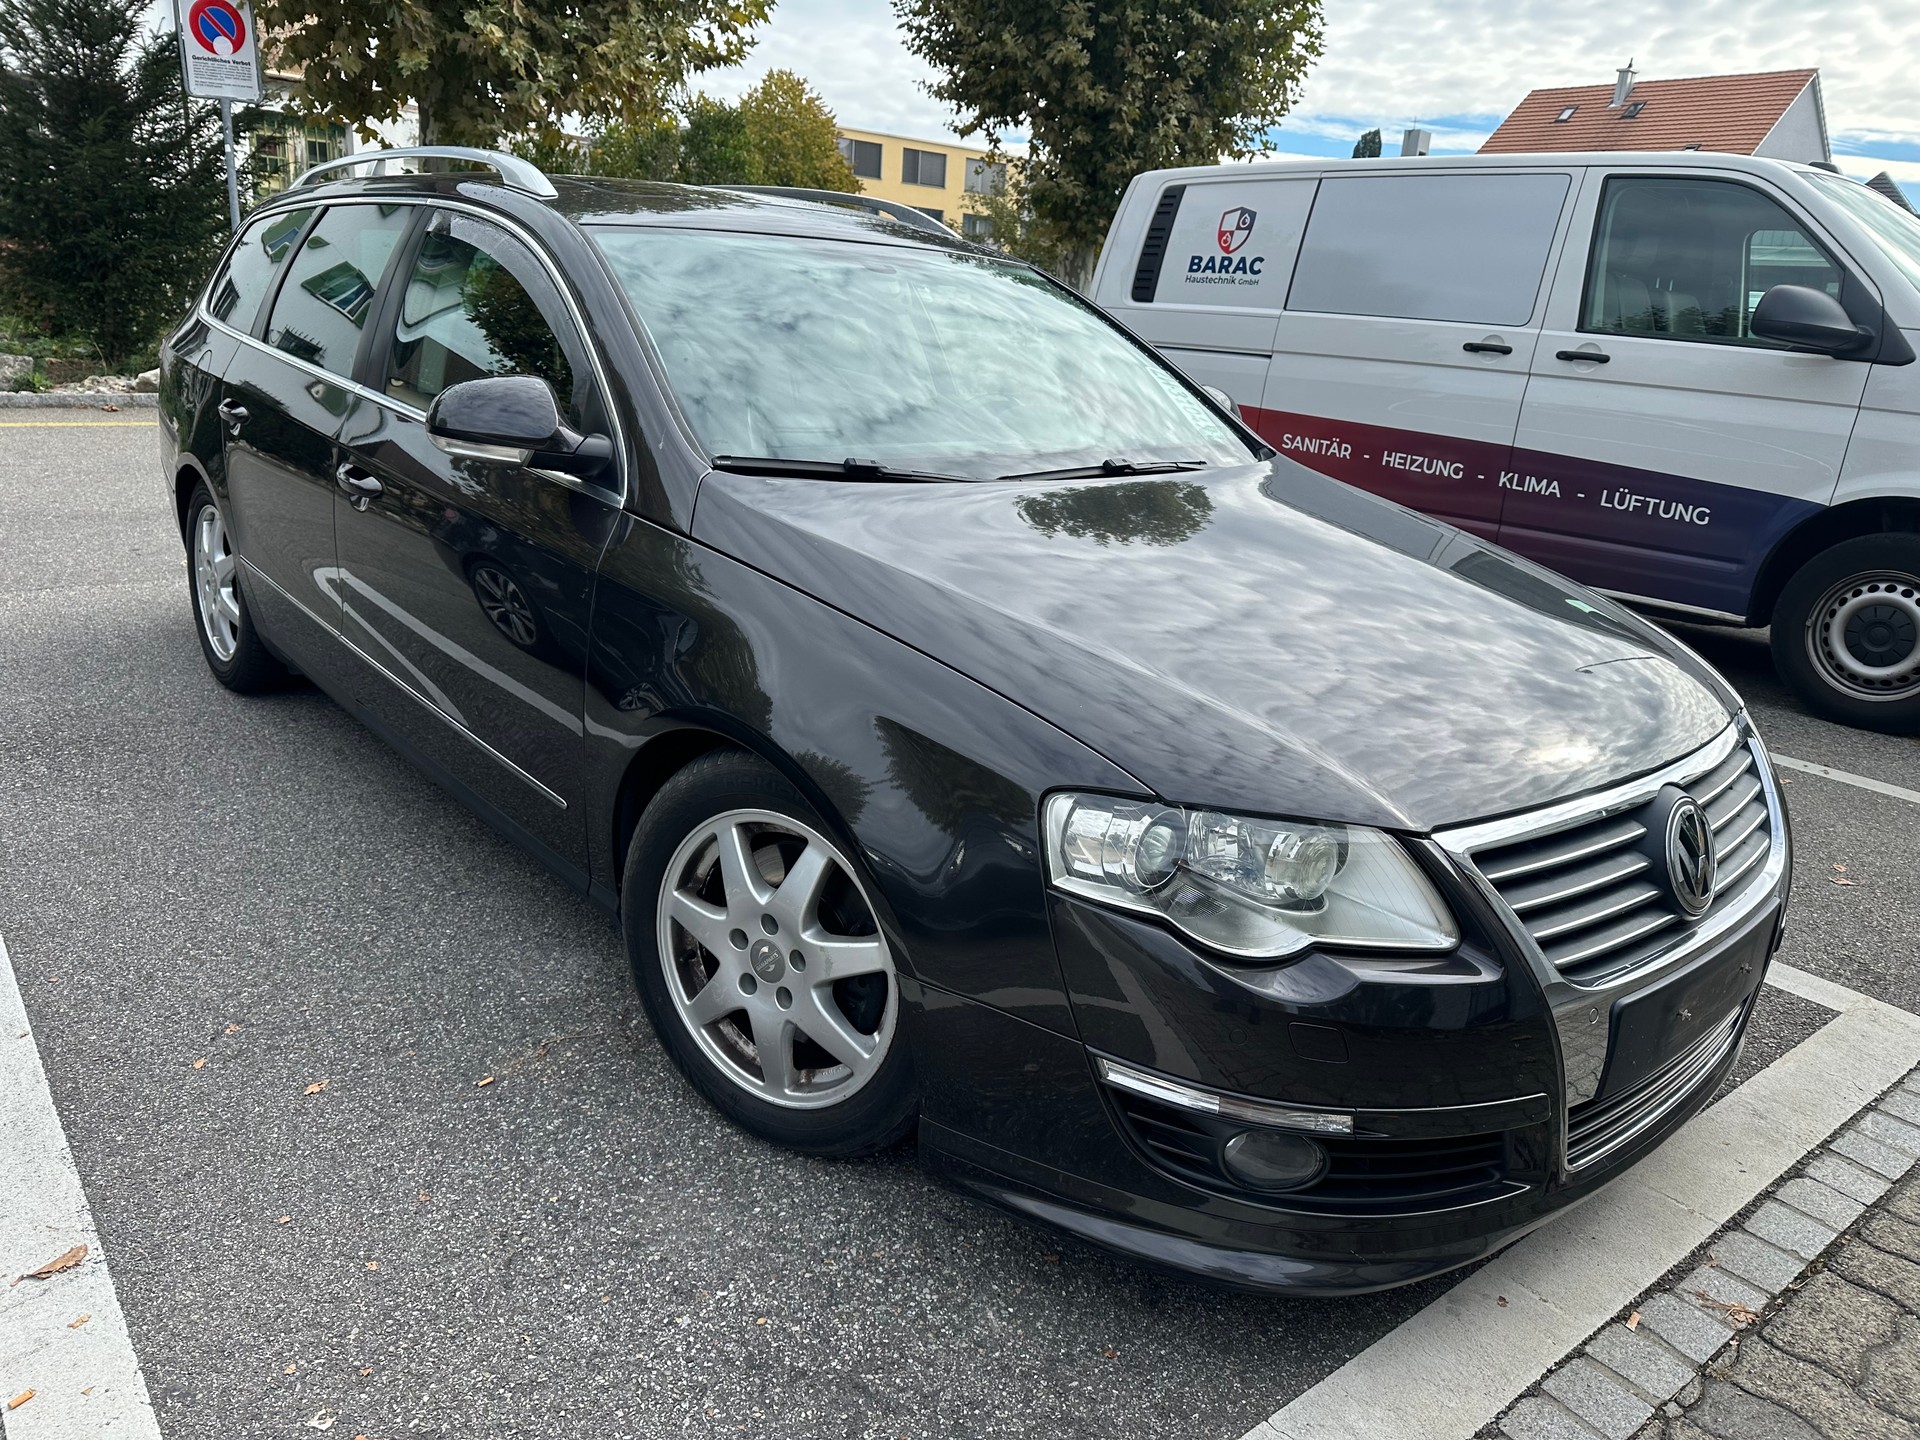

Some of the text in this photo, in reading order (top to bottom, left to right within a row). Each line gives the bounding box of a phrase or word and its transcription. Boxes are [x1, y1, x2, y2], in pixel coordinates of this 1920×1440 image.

[192, 54, 251, 67] Gerichtliches Verbot
[1187, 255, 1265, 275] BARAC
[1185, 275, 1260, 286] Haustechnik GmbH
[1282, 433, 1352, 459] SANITÄR
[1382, 450, 1464, 480] HEIZUNG
[1498, 471, 1561, 498] KLIMA
[1600, 487, 1711, 525] LÜFTUNG
